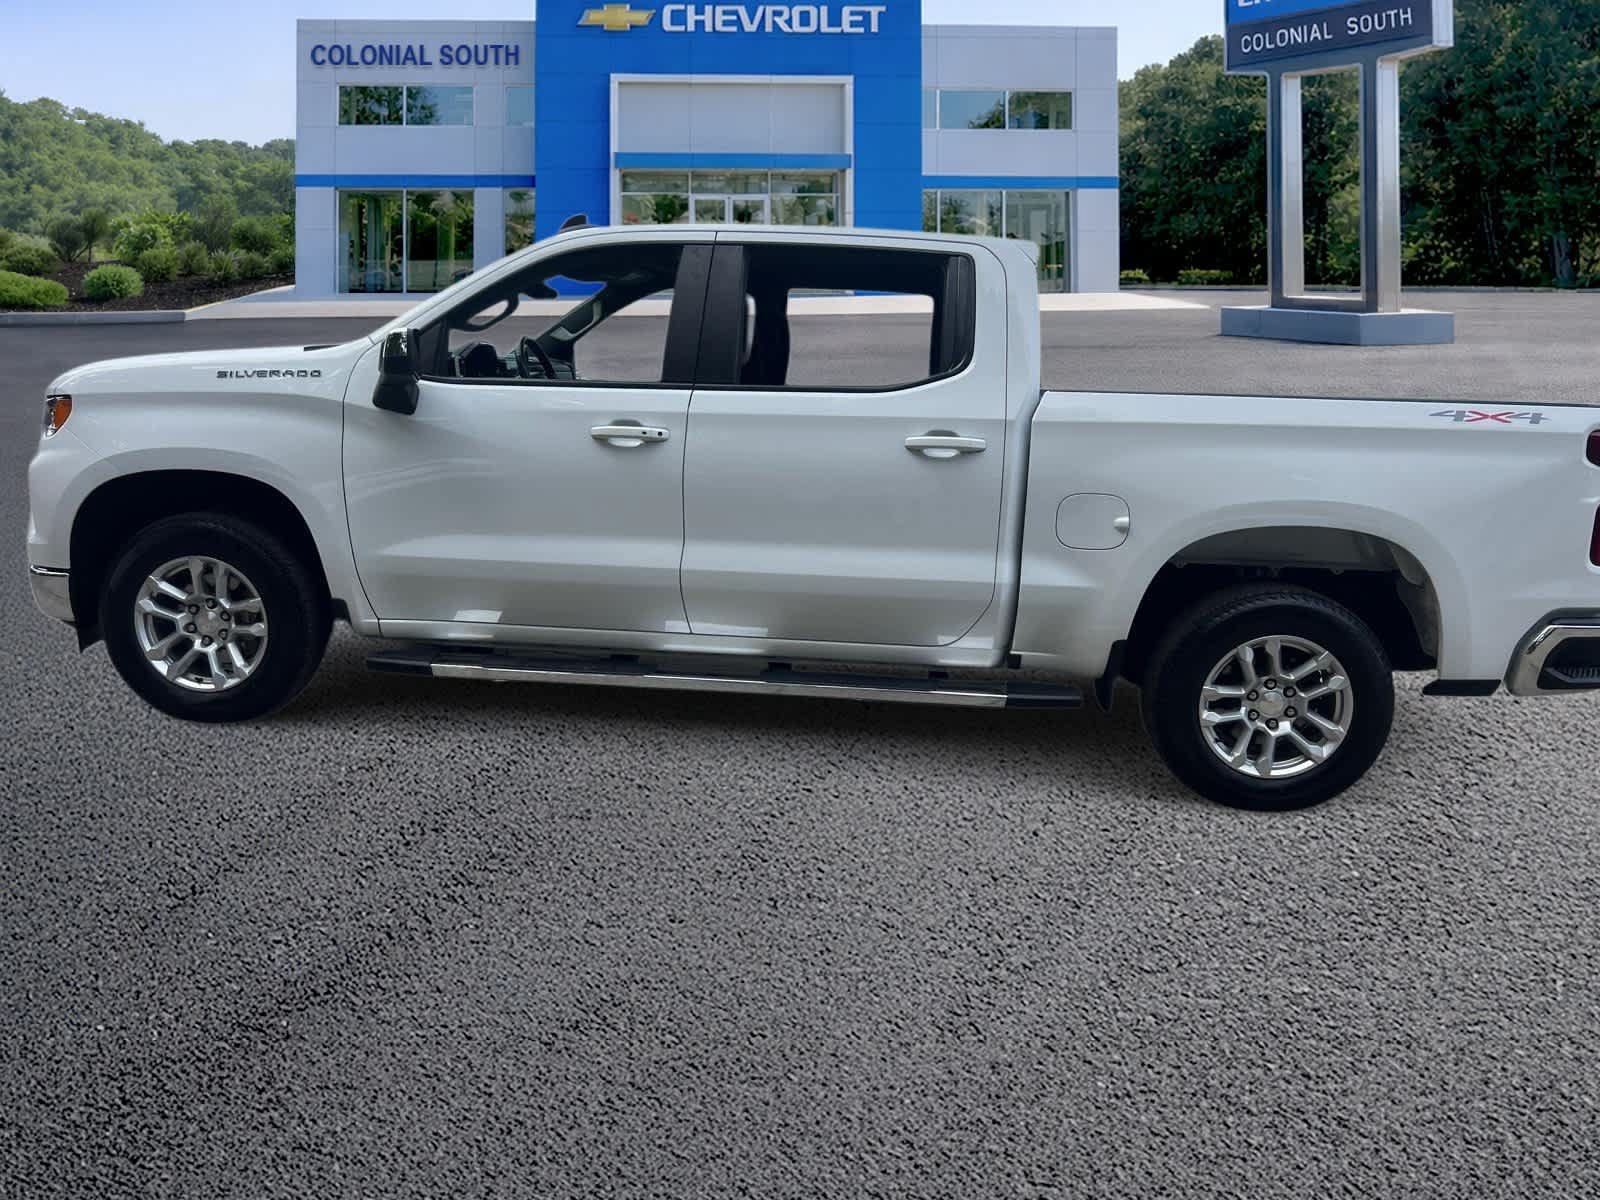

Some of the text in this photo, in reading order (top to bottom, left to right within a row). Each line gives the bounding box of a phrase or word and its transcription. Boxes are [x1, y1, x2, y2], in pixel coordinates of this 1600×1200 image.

[661, 4, 887, 34] CHEVROLET
[1240, 8, 1413, 54] COLONIAL SOUTH
[310, 43, 520, 67] COLONIAL SOUTH
[216, 369, 322, 379] SILVERADO
